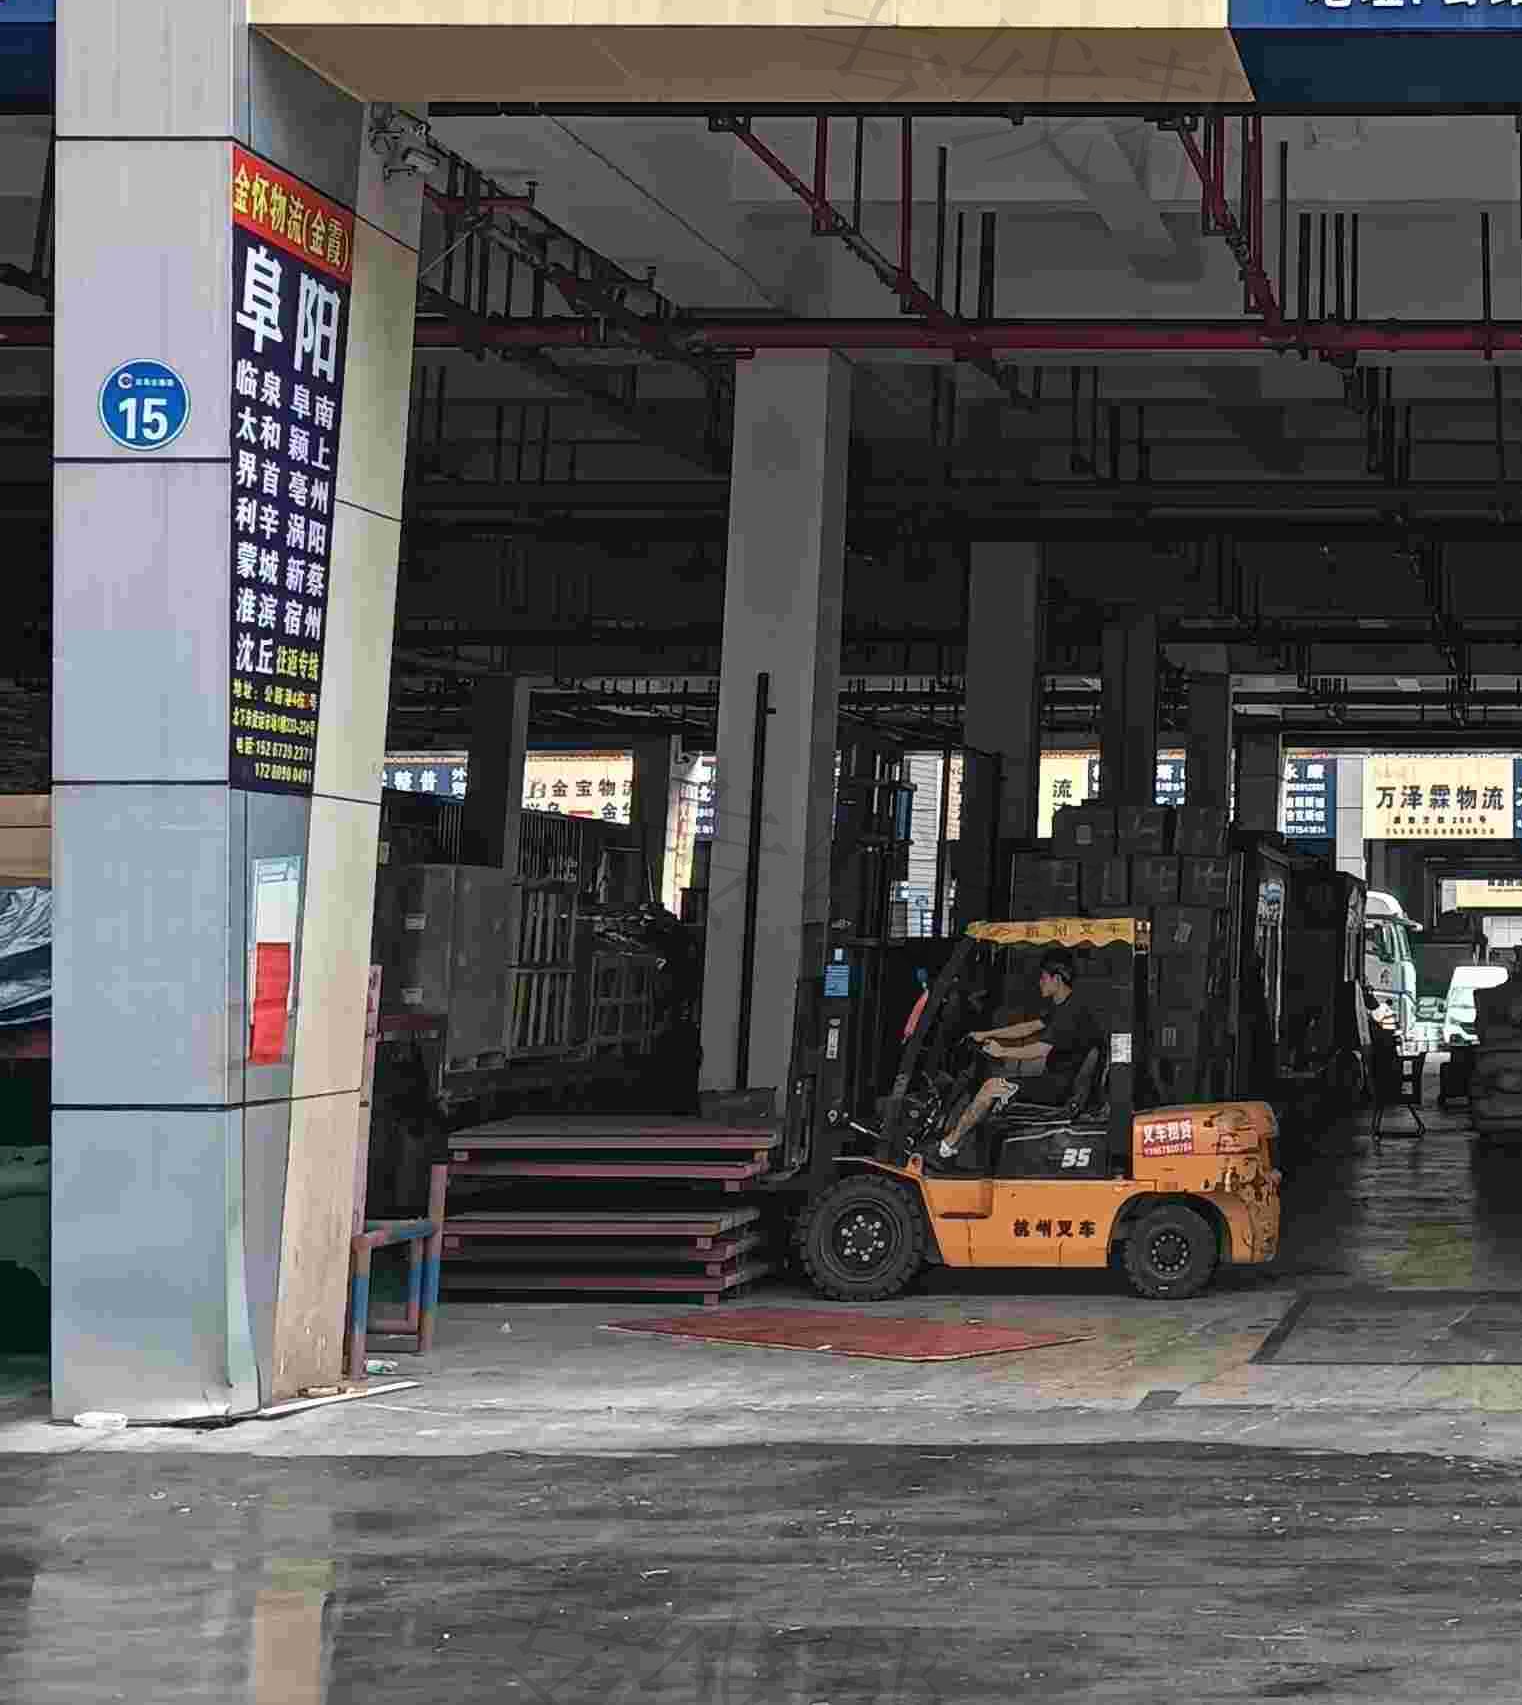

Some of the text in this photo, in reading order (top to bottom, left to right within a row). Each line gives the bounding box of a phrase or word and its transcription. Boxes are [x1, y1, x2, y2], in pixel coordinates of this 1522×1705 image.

[235, 244, 342, 384] 阜阳
[118, 397, 168, 440] 15
[235, 358, 336, 431] 临泉 阜南
[235, 406, 281, 451] 太和
[235, 449, 280, 497] 界首
[235, 497, 327, 556] 利辛 涡阳
[236, 541, 325, 597] 蒙城 新蔡
[235, 587, 322, 641] 淮滨 宿州
[1061, 1147, 1093, 1168] 35
